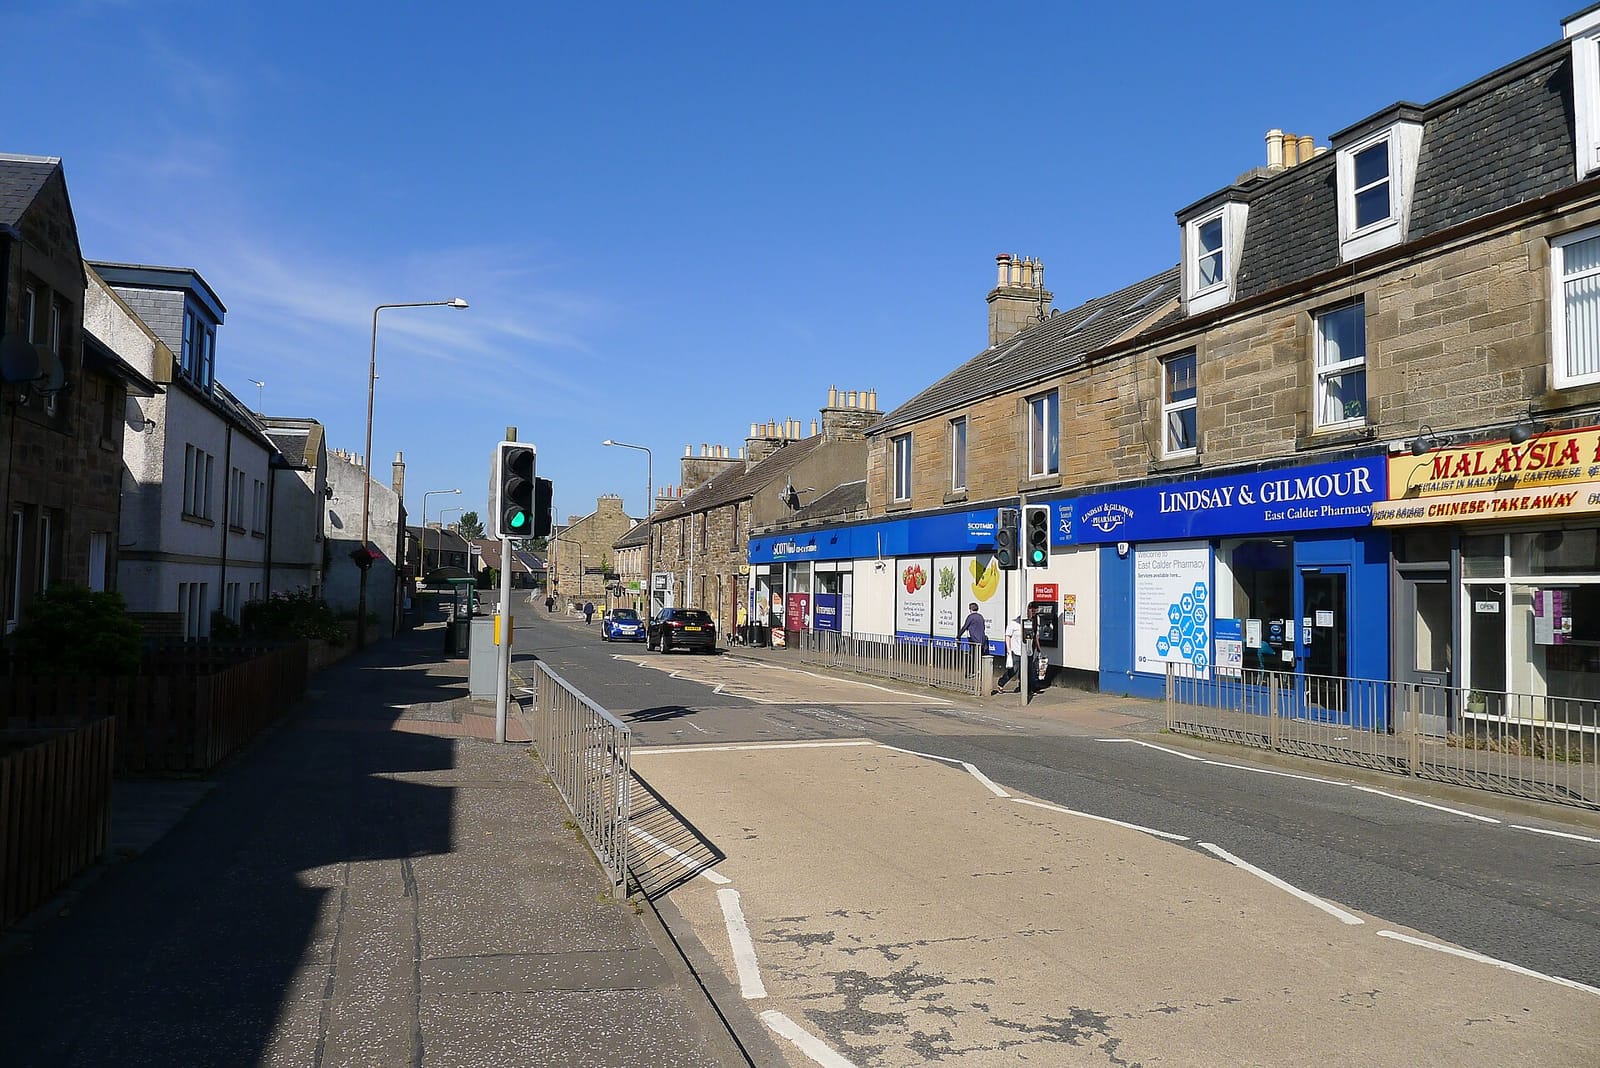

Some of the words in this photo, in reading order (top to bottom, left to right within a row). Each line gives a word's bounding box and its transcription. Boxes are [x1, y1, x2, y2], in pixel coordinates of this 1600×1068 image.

[1429, 438, 1580, 480] MALAYSIA
[1159, 485, 1234, 514] LINDSAY
[1239, 484, 1253, 504] &
[1259, 466, 1374, 503] GILMOUR
[1264, 509, 1285, 521] East
[1287, 506, 1318, 520] Calder
[1320, 503, 1372, 519] Pharmacy
[1428, 499, 1485, 517] CHINESE
[1491, 491, 1578, 512] TAKEAWAY
[1137, 560, 1151, 570] East
[1151, 560, 1172, 570] Calder
[1173, 559, 1206, 570] Pharmacy
[1479, 602, 1495, 610] OPEN
